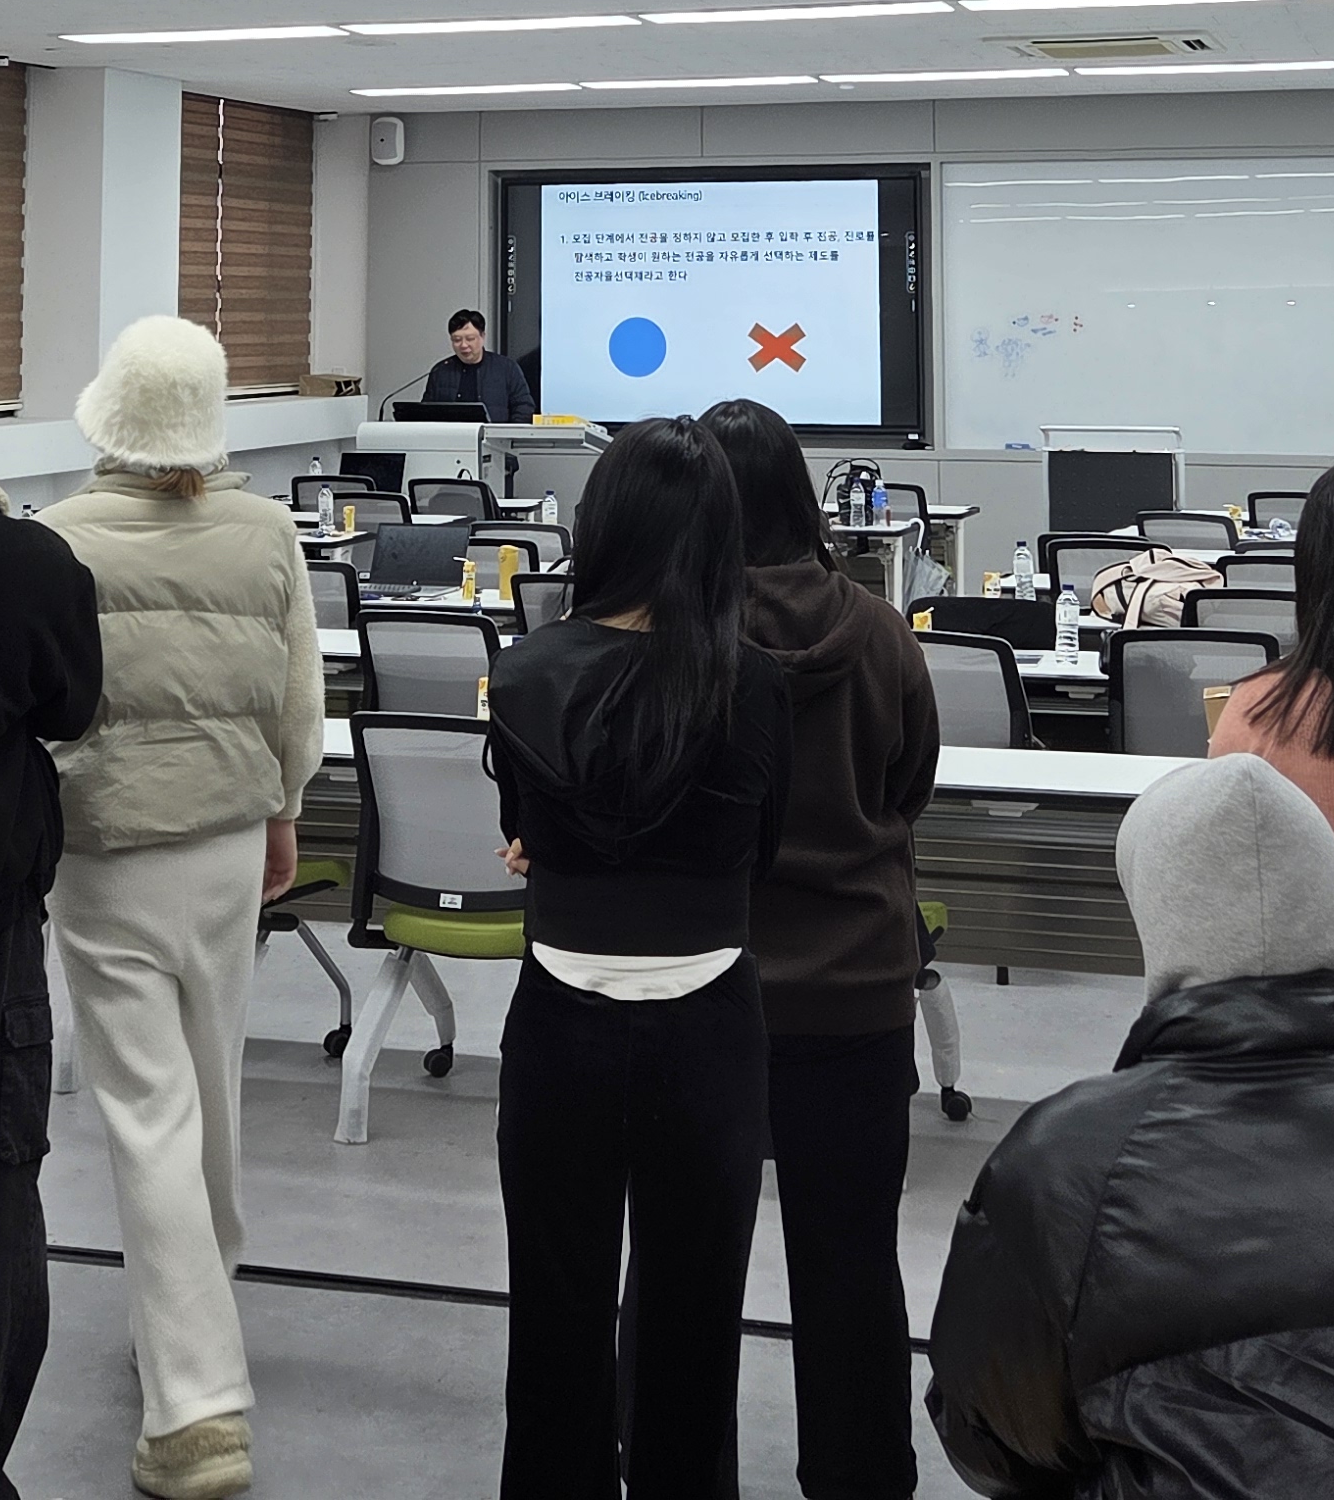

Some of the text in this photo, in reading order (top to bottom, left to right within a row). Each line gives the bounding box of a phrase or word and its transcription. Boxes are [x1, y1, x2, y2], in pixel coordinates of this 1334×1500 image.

[558, 191, 591, 203] 아이스
[593, 190, 635, 203] 브레이킹
[572, 233, 591, 244] 모집
[595, 233, 635, 244] 단계에서
[672, 232, 702, 243] 정하지
[764, 231, 774, 243] 후
[803, 231, 813, 242] 후
